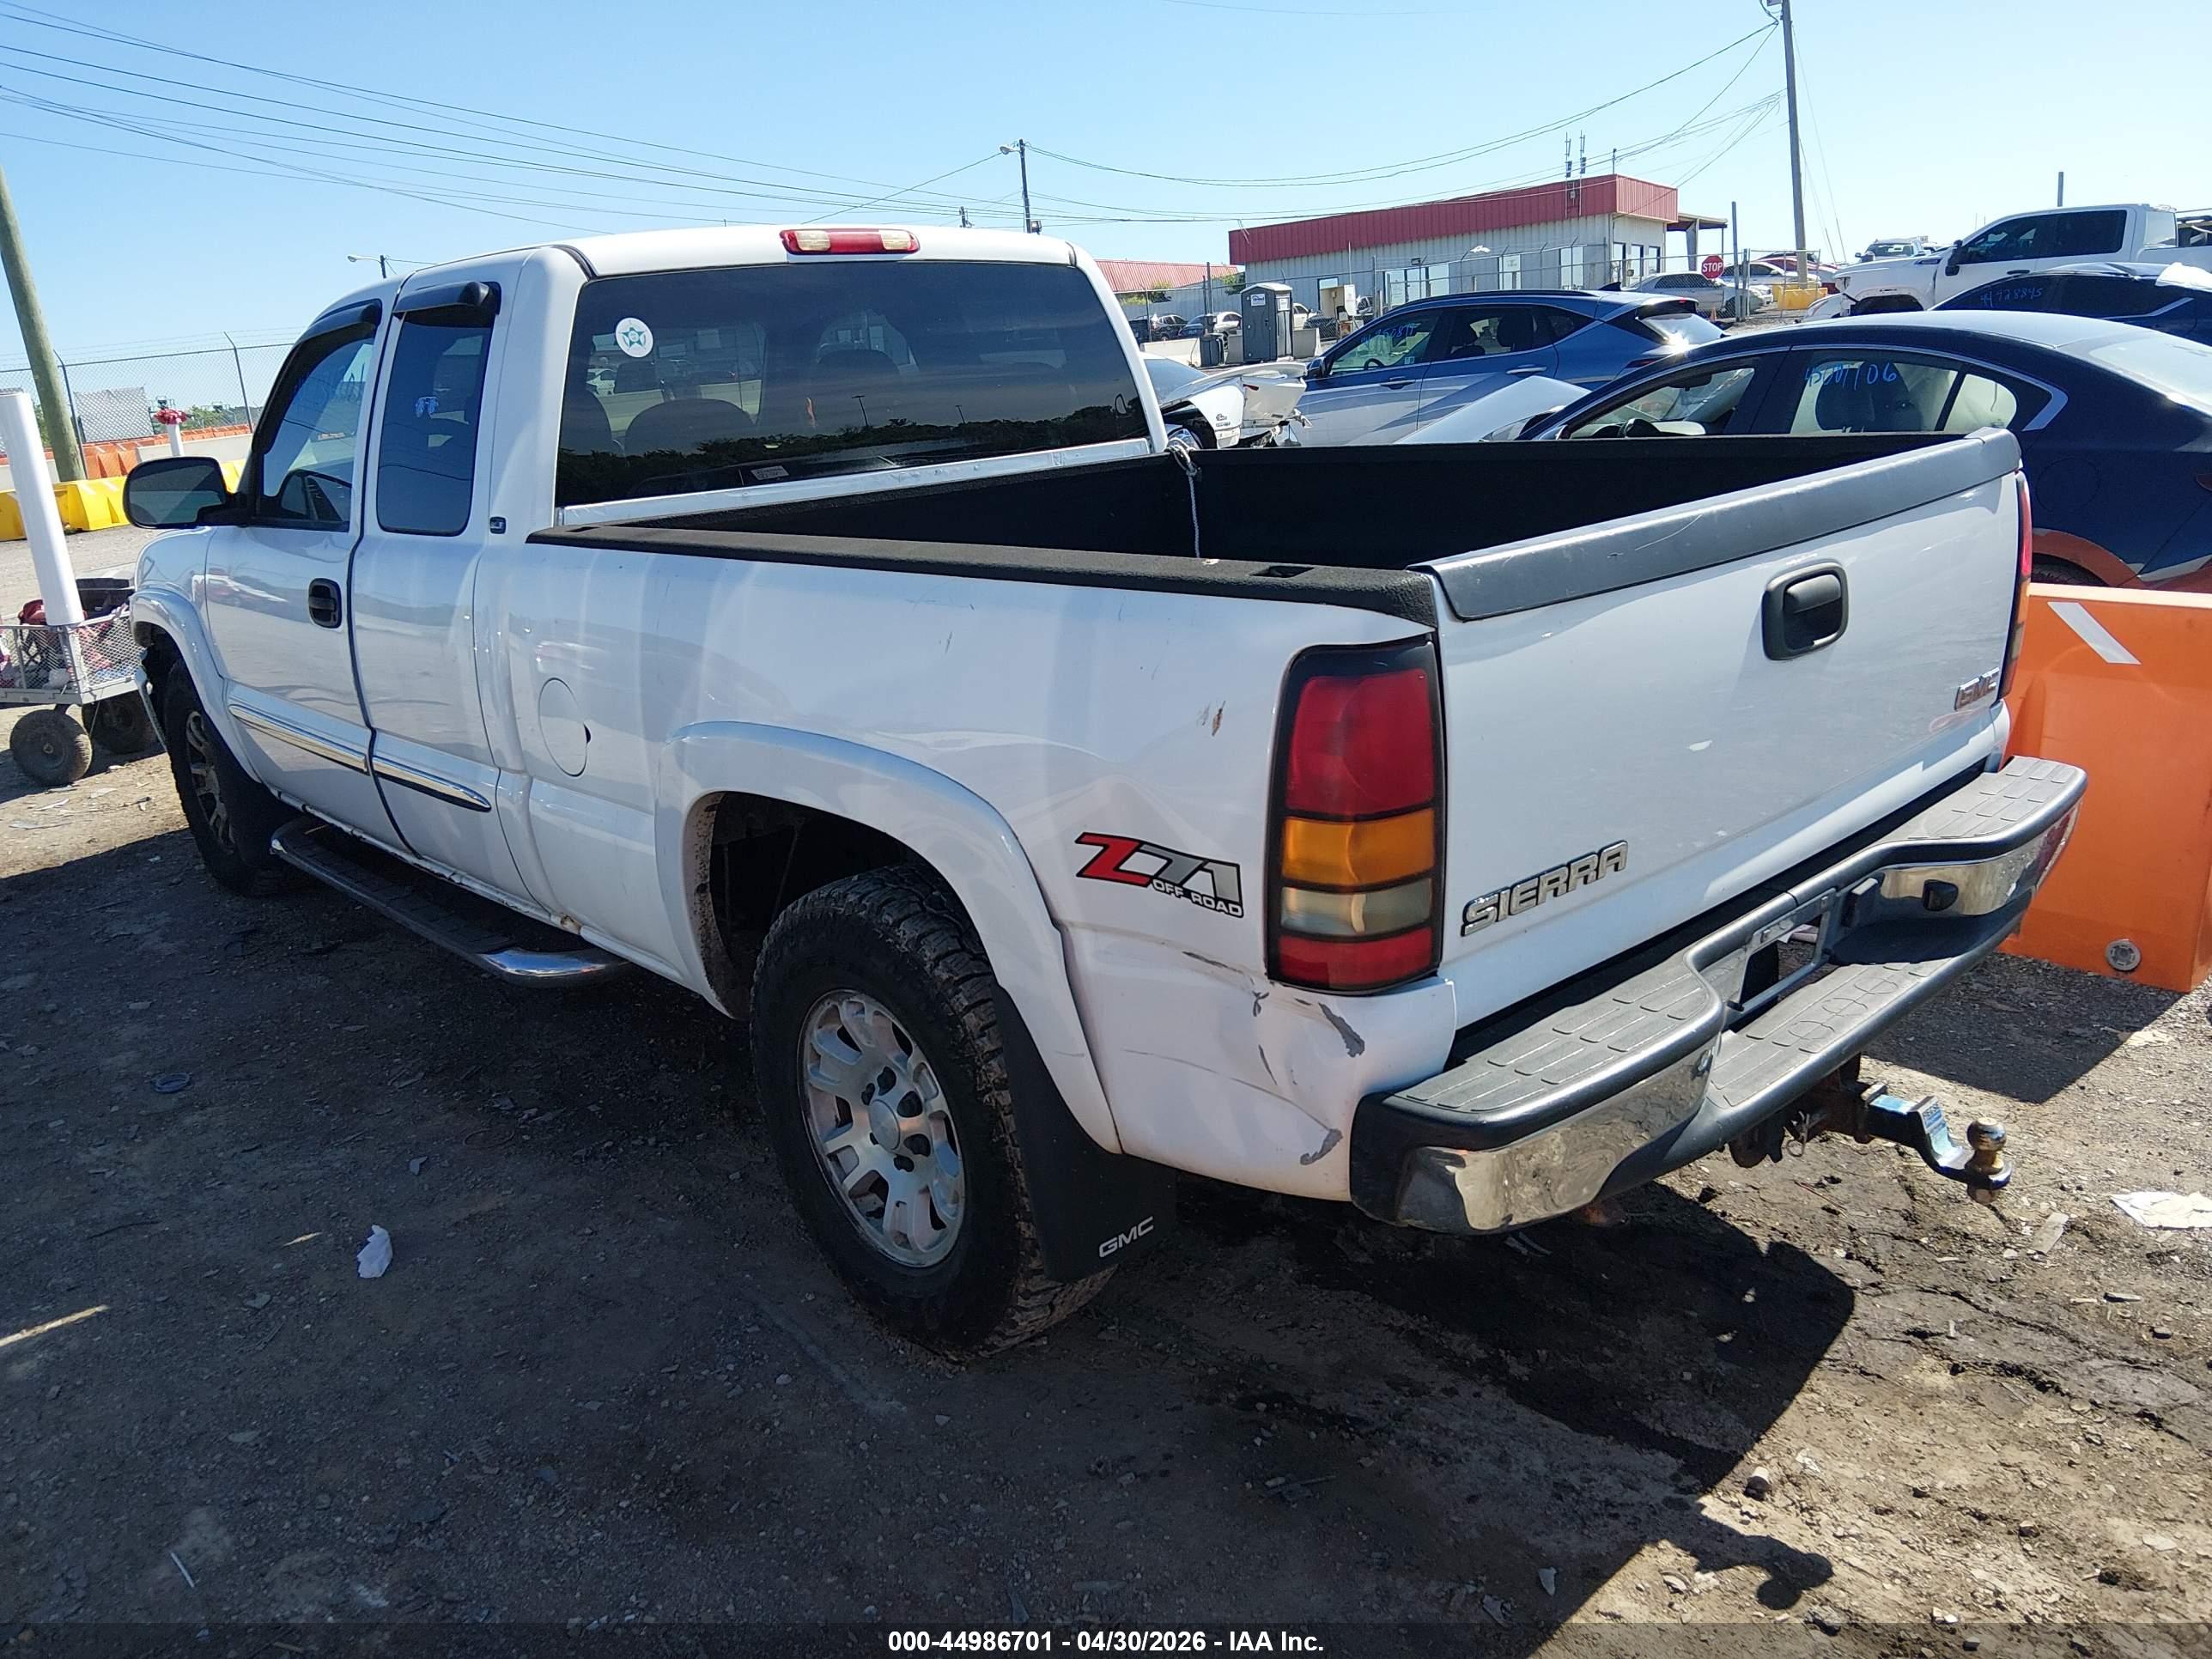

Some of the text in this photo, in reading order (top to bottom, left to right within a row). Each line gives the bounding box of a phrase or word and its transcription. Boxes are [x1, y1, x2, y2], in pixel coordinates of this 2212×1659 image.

[1703, 262, 1723, 272] STOP
[1956, 668, 1999, 708] GMC
[1074, 832, 1243, 904] Z71
[1152, 878, 1243, 917] OFF ROAD
[1461, 840, 1628, 937] SIERRA
[1099, 1216, 1154, 1257] GMC
